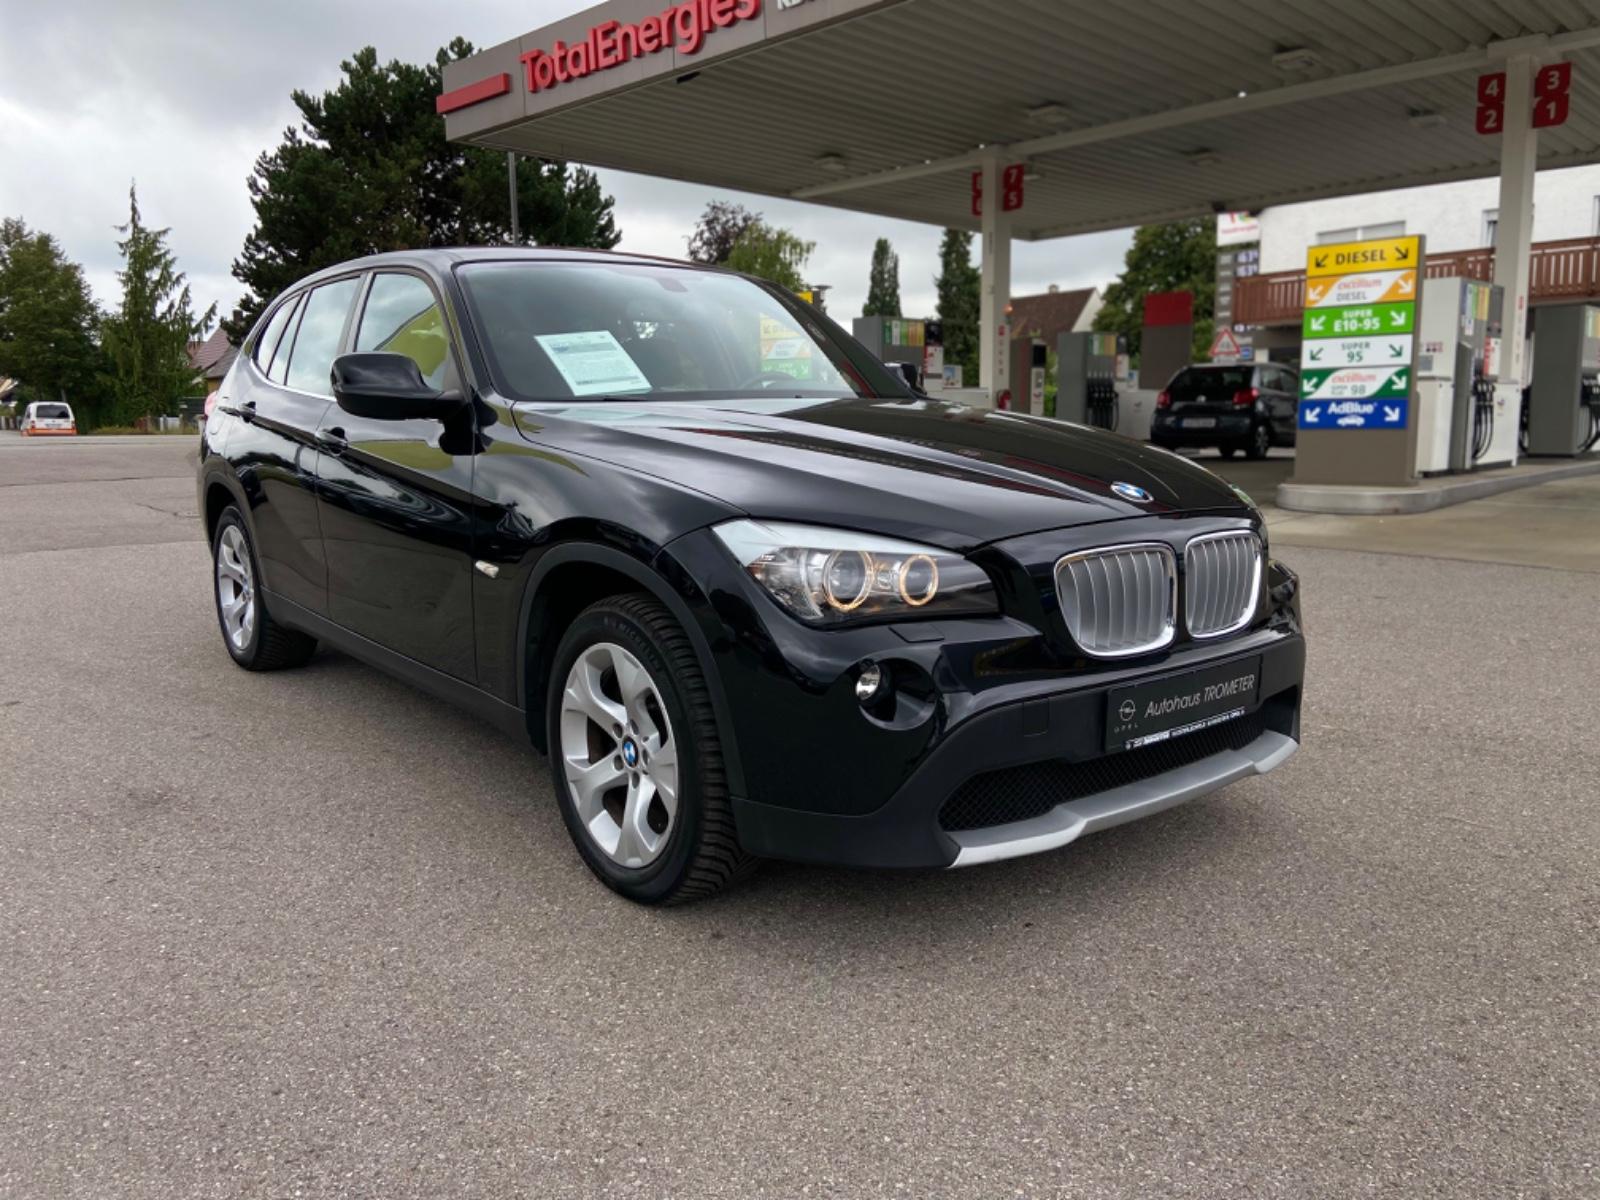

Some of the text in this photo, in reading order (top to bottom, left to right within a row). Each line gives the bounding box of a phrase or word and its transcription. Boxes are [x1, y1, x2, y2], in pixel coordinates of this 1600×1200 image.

[520, 0, 760, 92] TotalEnergies
[1485, 79, 1499, 97] 4
[1547, 70, 1559, 90] 3
[1546, 101, 1557, 120] 1
[1484, 109, 1498, 129] 2
[1335, 249, 1386, 265] DIESEL
[1336, 291, 1367, 302] DIESEL
[1342, 309, 1372, 319] SUPER
[1334, 317, 1380, 332] E10-95
[1341, 341, 1370, 350] SUPER
[1347, 350, 1363, 363] 95
[1350, 384, 1366, 396] 98
[1144, 674, 1255, 718] Autohaus TROMETER
